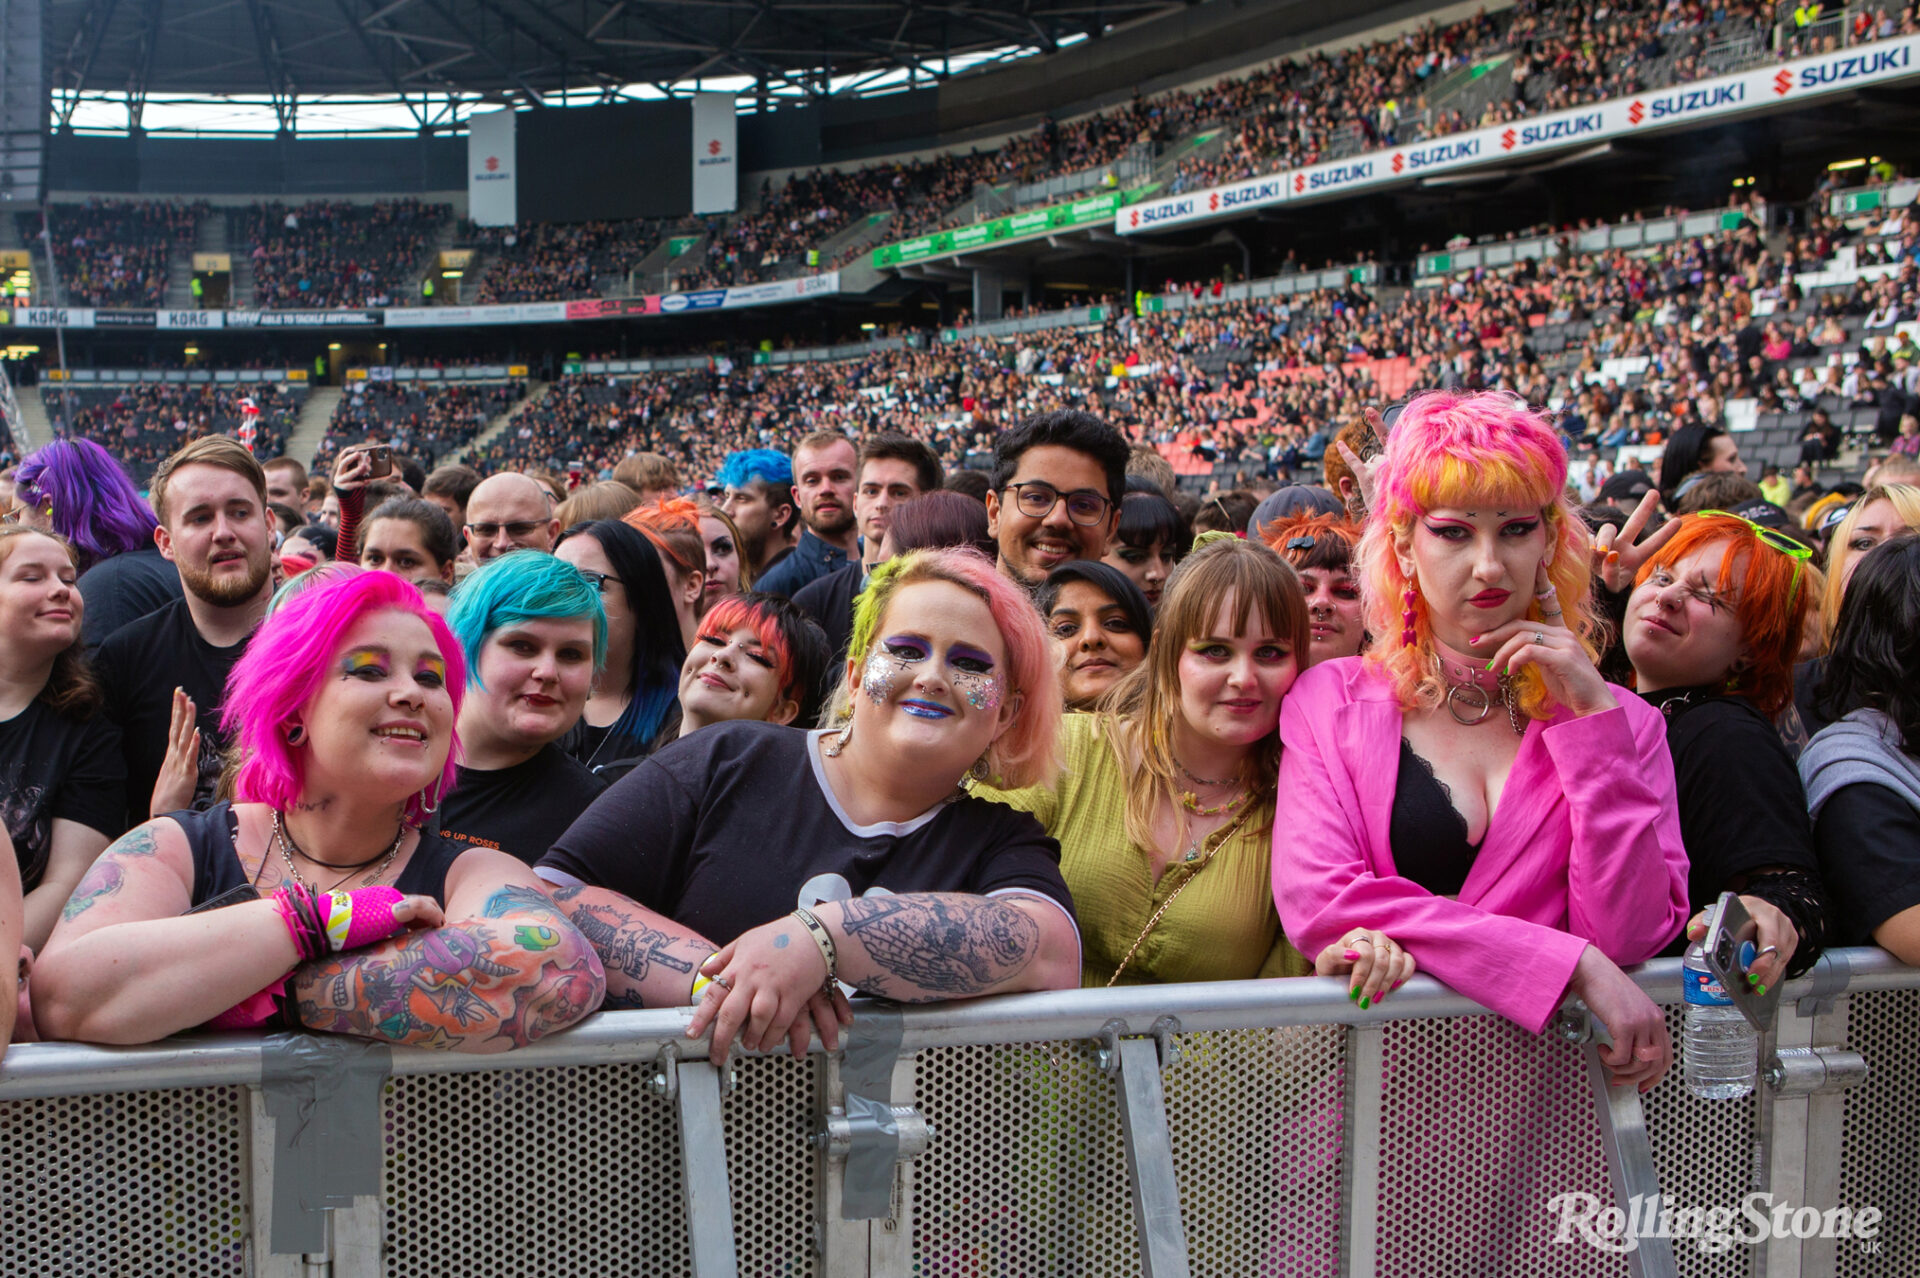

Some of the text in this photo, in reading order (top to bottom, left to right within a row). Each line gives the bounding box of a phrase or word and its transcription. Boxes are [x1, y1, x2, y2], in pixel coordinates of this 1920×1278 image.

[1800, 46, 1910, 88] SUZUKI
[1651, 82, 1745, 119] SUZUKI
[1521, 113, 1602, 145] SUZUKI
[1409, 139, 1480, 169] SUZUKI
[1309, 162, 1373, 189] SUZUKI
[1222, 182, 1280, 207] SUZUKI
[1142, 201, 1194, 223] SUZUKI
[28, 310, 69, 325] KORG
[169, 311, 209, 326] KORG
[453, 832, 468, 841] UP
[468, 836, 500, 850] ROSES
